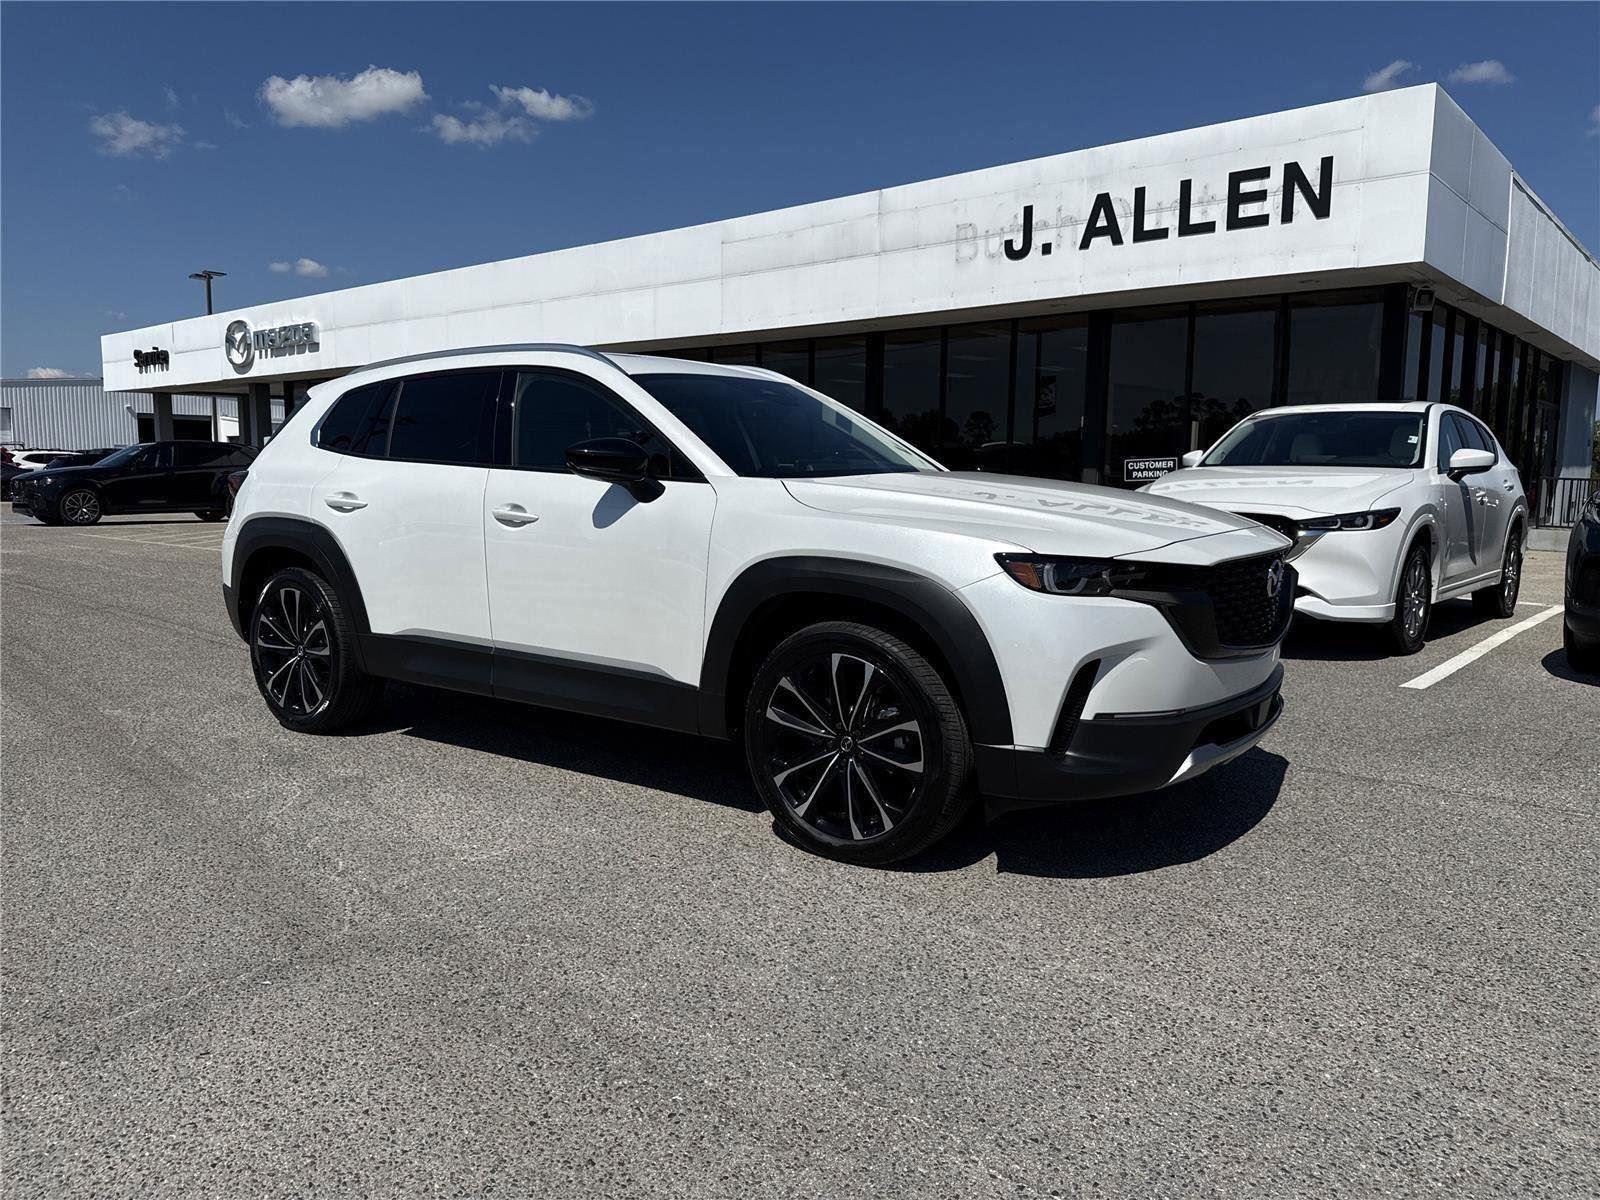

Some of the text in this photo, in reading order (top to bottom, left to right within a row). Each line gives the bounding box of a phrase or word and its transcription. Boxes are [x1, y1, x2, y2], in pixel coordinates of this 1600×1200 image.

[1003, 204, 1053, 261] J.
[1078, 155, 1334, 250] ALLEN
[1128, 461, 1174, 470] CUSTOMER
